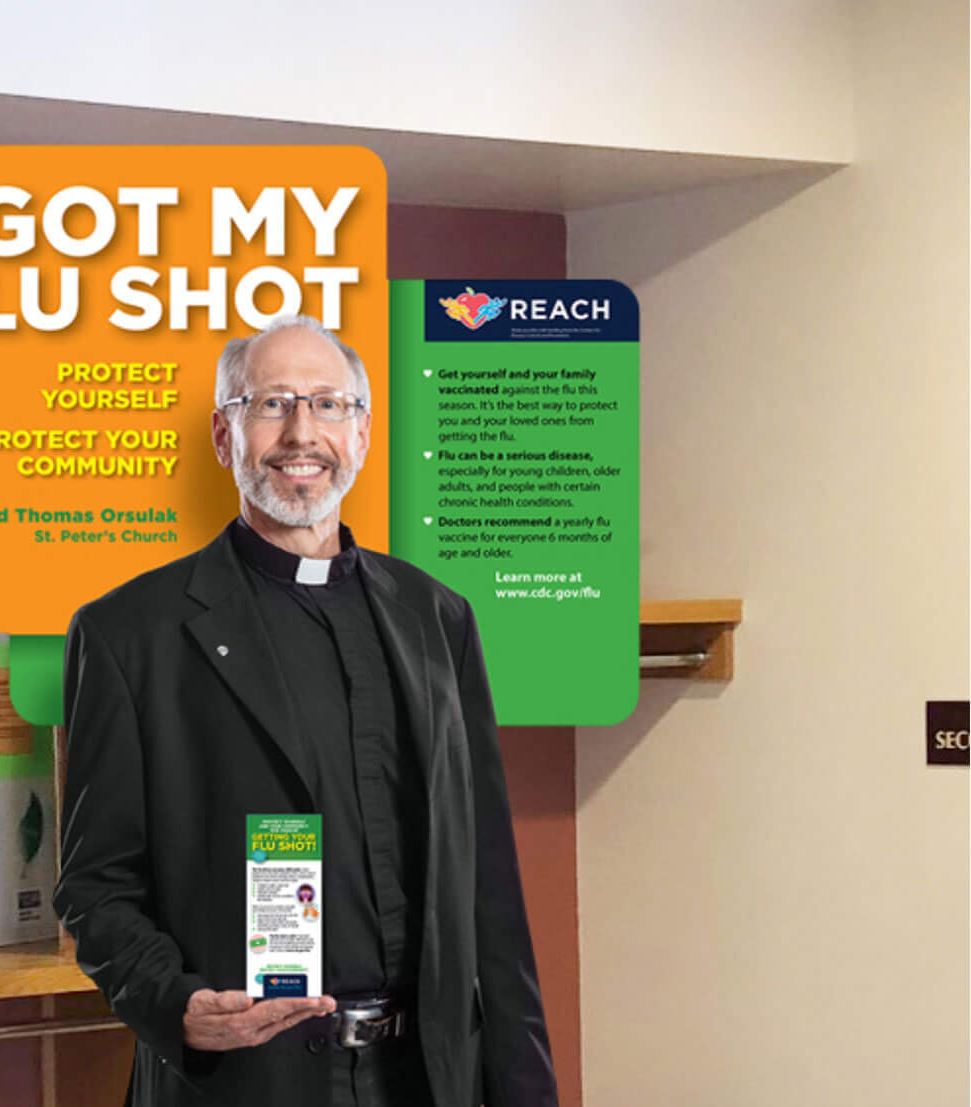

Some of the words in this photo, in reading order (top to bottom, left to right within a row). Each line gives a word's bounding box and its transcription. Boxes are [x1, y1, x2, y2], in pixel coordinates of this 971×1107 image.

[212, 187, 360, 256] MY
[109, 266, 359, 331] SHOT
[511, 299, 610, 320] REACH
[57, 364, 177, 383] PROTECT
[439, 369, 458, 379] Get
[461, 369, 506, 383] yourself
[509, 369, 530, 379] and
[533, 372, 557, 383] your
[561, 369, 596, 383] family
[439, 385, 499, 394] vaccinated
[502, 385, 540, 398] against
[542, 385, 559, 394] the
[562, 385, 576, 394] flu
[579, 385, 597, 394] this
[42, 389, 177, 409] YOURSELF
[480, 400, 494, 410] It's
[497, 400, 514, 410] the
[517, 400, 539, 410] best
[542, 403, 563, 414] way
[566, 401, 577, 410] to
[579, 401, 617, 414] protect
[439, 418, 458, 429] you
[461, 416, 480, 425] and
[483, 418, 507, 429] your
[509, 416, 538, 425] loved
[569, 415, 594, 425] from
[105, 430, 177, 449] YOUR
[439, 432, 477, 445] getting
[480, 432, 497, 441] the
[500, 431, 516, 441] flu.
[439, 451, 455, 460] Flu
[480, 451, 494, 460] be
[506, 451, 546, 460] serious
[549, 451, 593, 462] disease,
[18, 457, 177, 476] COMMUNITY
[439, 466, 490, 480] especially
[492, 466, 506, 476] for
[509, 468, 543, 480] young
[545, 466, 591, 477] children,
[593, 466, 620, 476] older
[439, 482, 473, 493] adults,
[476, 482, 495, 492] and
[499, 482, 535, 495] people
[538, 482, 560, 492] with
[563, 482, 600, 492] certain
[439, 497, 477, 507] chronic
[480, 497, 514, 507] health
[516, 497, 574, 507] conditions.
[15, 508, 93, 524] Thomas
[101, 508, 177, 524] Orsulak
[439, 517, 482, 527] Doctors
[485, 517, 551, 527] recommend
[555, 519, 560, 527] a
[563, 517, 594, 531] yearly
[596, 517, 610, 527] flu
[34, 530, 55, 543] St.
[61, 530, 116, 544] Peter's
[121, 530, 177, 543] Church
[439, 532, 478, 542] vaccine
[480, 532, 495, 542] for
[498, 534, 546, 546] everyone
[549, 533, 555, 542] 6
[558, 532, 598, 542] months
[601, 532, 612, 542] of
[439, 550, 458, 561] age
[461, 547, 480, 557] and
[483, 547, 512, 557] older.
[496, 572, 531, 582] Learn
[569, 573, 582, 582] at
[496, 587, 600, 600] www.cdc.gov/flu
[253, 841, 275, 851] FLU
[279, 841, 316, 851] SHOT!
